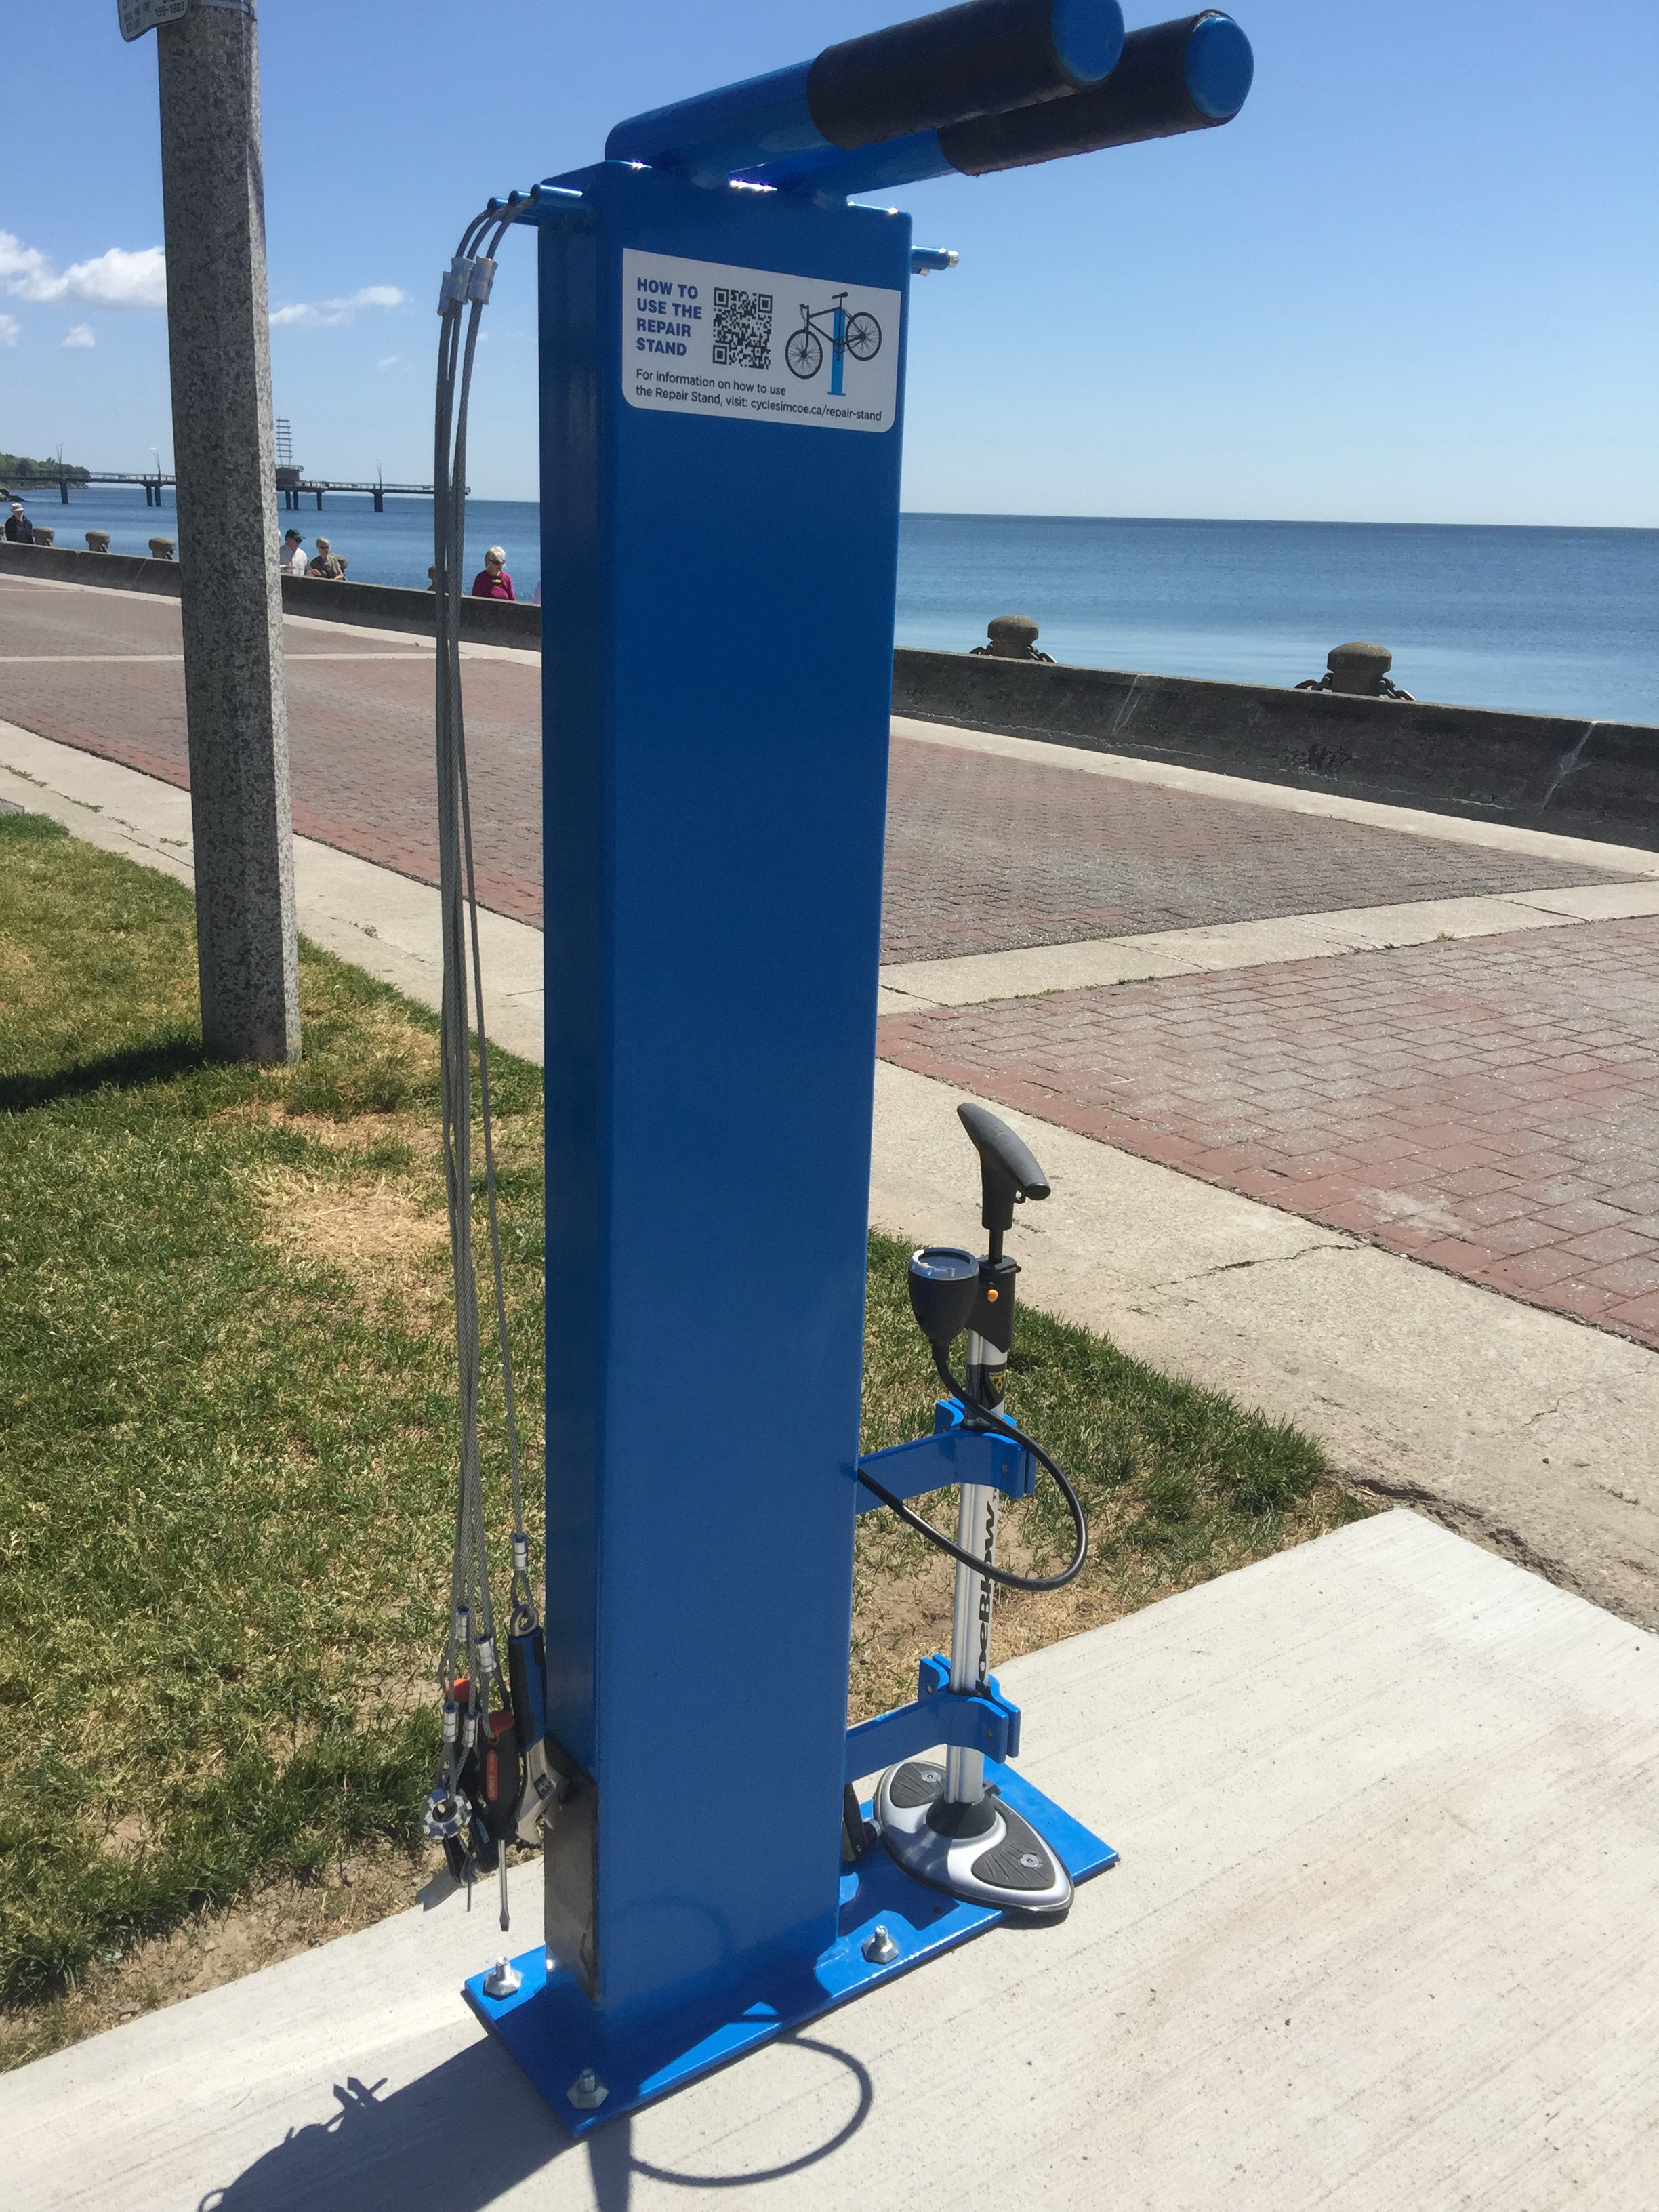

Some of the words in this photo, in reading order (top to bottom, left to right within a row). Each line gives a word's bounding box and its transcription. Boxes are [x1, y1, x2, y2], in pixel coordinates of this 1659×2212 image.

[637, 277, 673, 295] HOW
[678, 283, 699, 300] TO
[637, 298, 667, 315] USE
[672, 302, 703, 320] THE
[636, 317, 691, 338] REPAIR
[636, 337, 687, 356] STAND
[636, 368, 653, 380] For
[656, 371, 715, 388] information
[718, 380, 731, 390] on
[733, 380, 754, 392] how
[757, 383, 767, 394] to
[770, 387, 787, 396] use
[636, 385, 653, 397] the
[655, 387, 689, 401] Repair
[691, 391, 723, 407] Stand,
[726, 395, 748, 407] visit:
[751, 398, 882, 422] cyclesimcoe.ca/repair-stand
